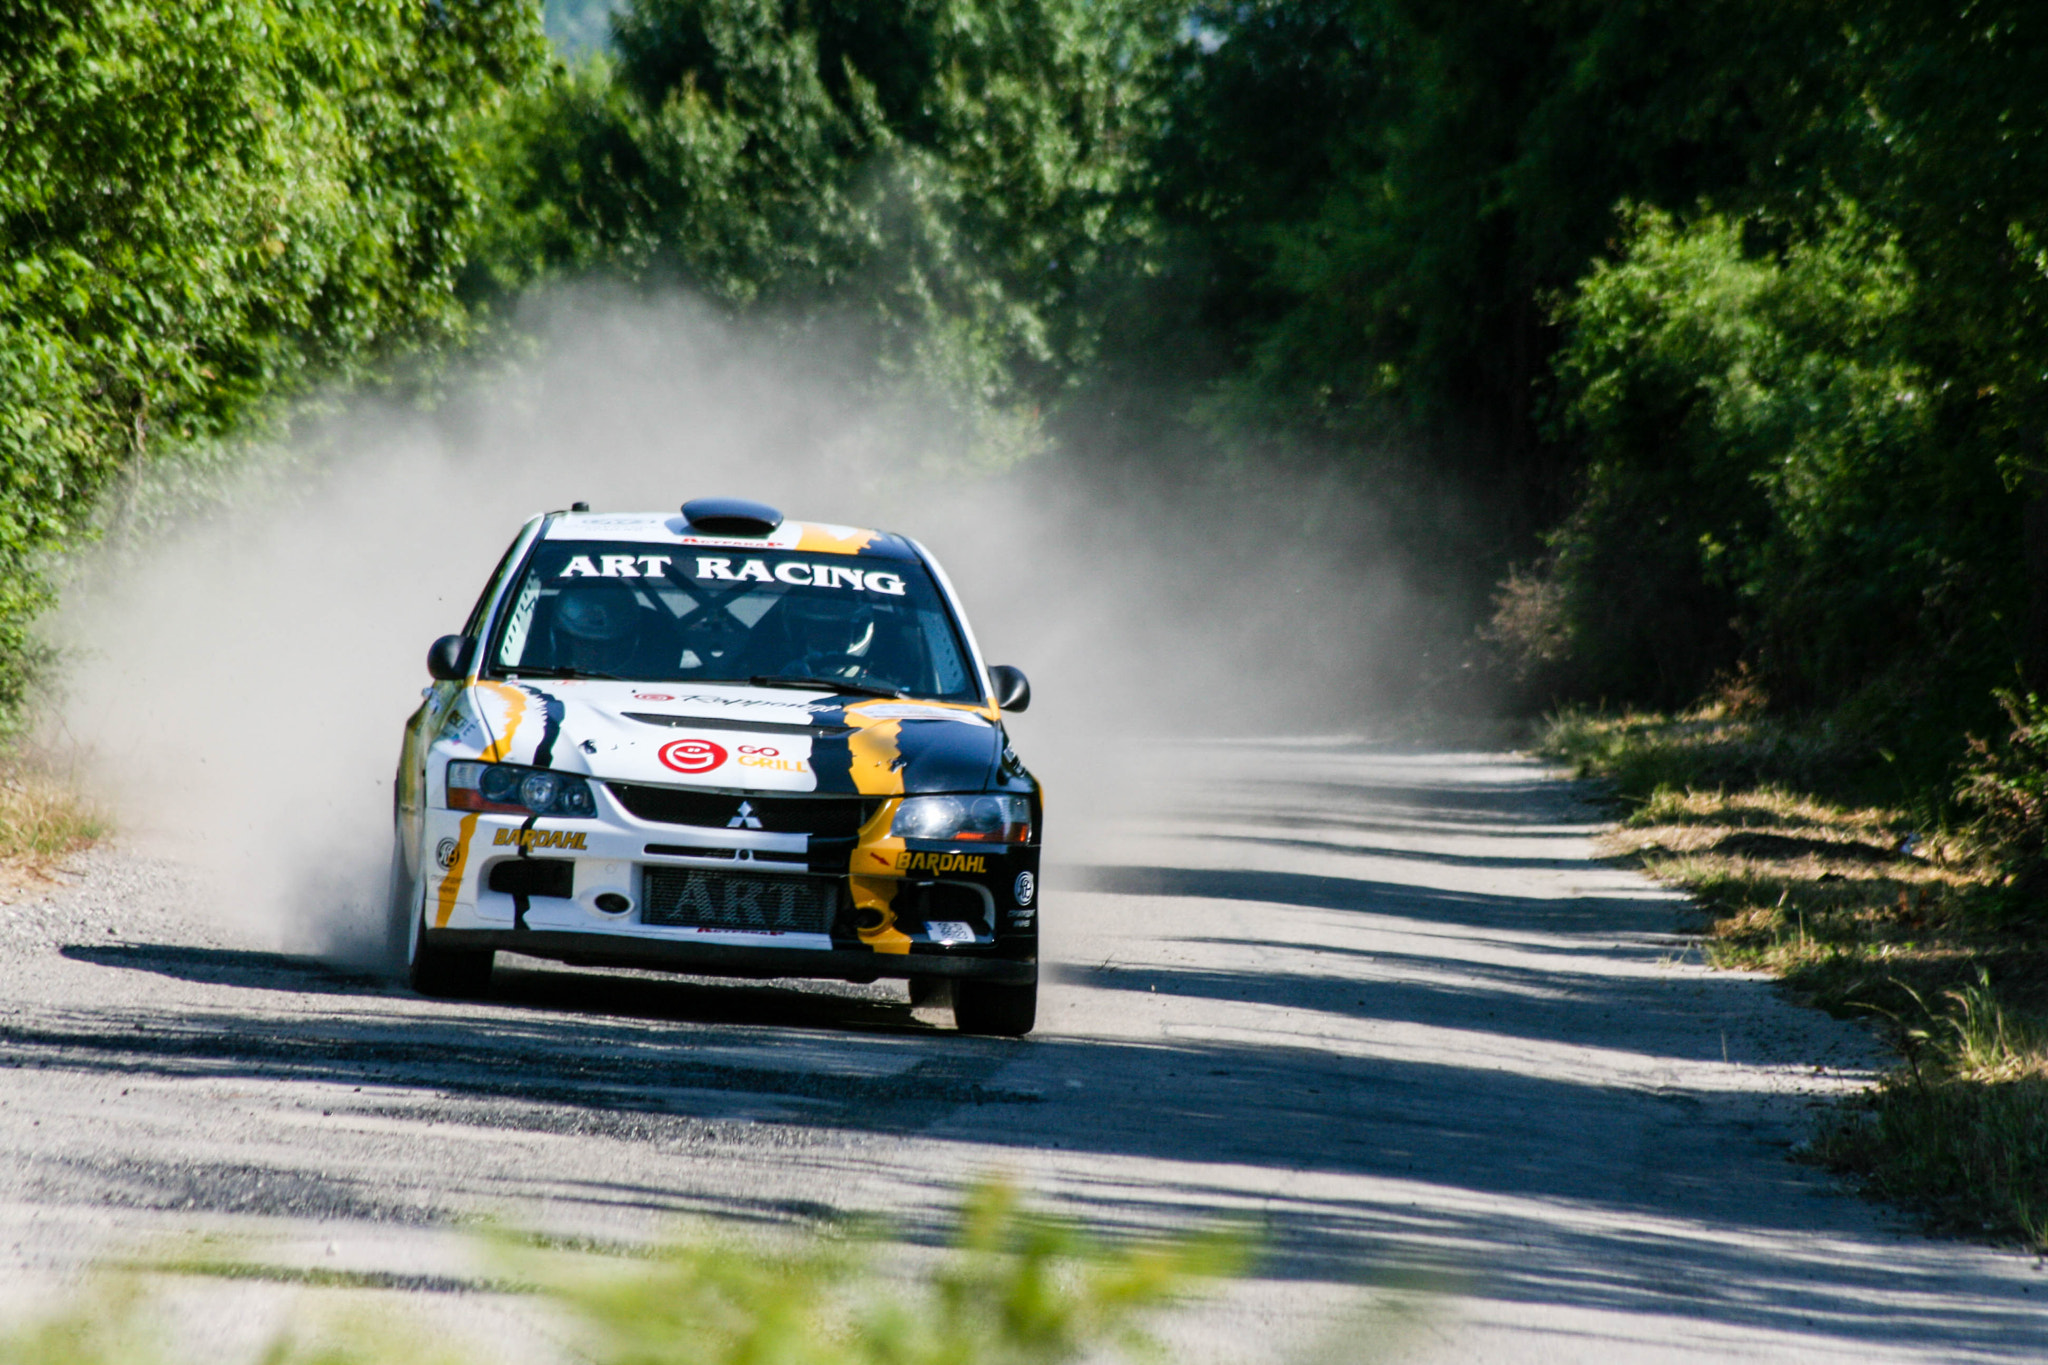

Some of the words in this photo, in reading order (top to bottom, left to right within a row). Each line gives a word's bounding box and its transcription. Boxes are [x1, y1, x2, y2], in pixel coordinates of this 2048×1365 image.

[559, 554, 672, 578] ART
[695, 557, 906, 596] RACING
[737, 744, 780, 757] GO
[737, 755, 809, 773] GRILL
[493, 828, 588, 853] BARDAHL
[895, 852, 988, 876] BARDAHL
[665, 870, 808, 927] ART
